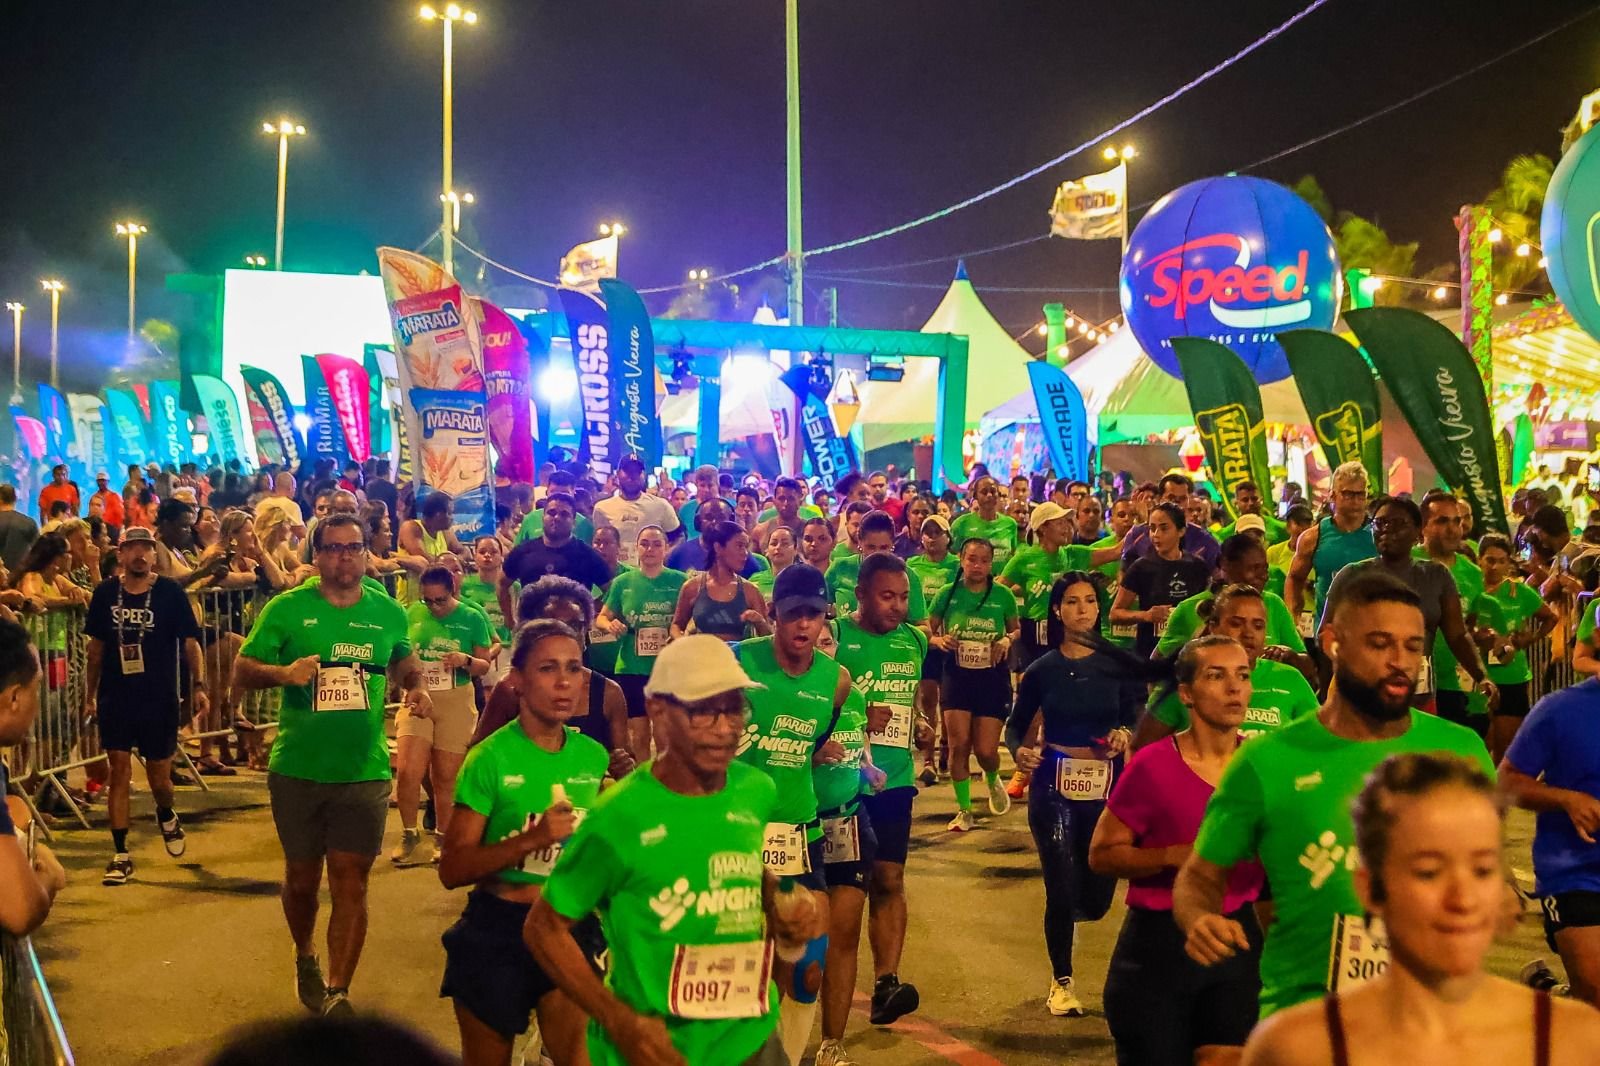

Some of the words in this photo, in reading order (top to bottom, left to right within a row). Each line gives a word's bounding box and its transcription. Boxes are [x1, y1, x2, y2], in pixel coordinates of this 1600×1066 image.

[1149, 249, 1309, 320] Speed
[623, 325, 643, 378] Vieira
[1436, 367, 1474, 441] Vieira
[625, 379, 648, 453] Augusto
[1335, 408, 1362, 463] ATA
[1215, 410, 1251, 493] ARATA
[319, 689, 349, 701] 0788
[873, 679, 919, 692] NIGHT
[1245, 710, 1279, 723] ARATA
[758, 736, 815, 754] NIGHT
[1063, 778, 1092, 792] 0560
[534, 846, 562, 863] 107
[762, 849, 787, 866] 038
[697, 887, 763, 917] NIGH
[1347, 957, 1388, 980] 30
[683, 980, 731, 1003] 0997
